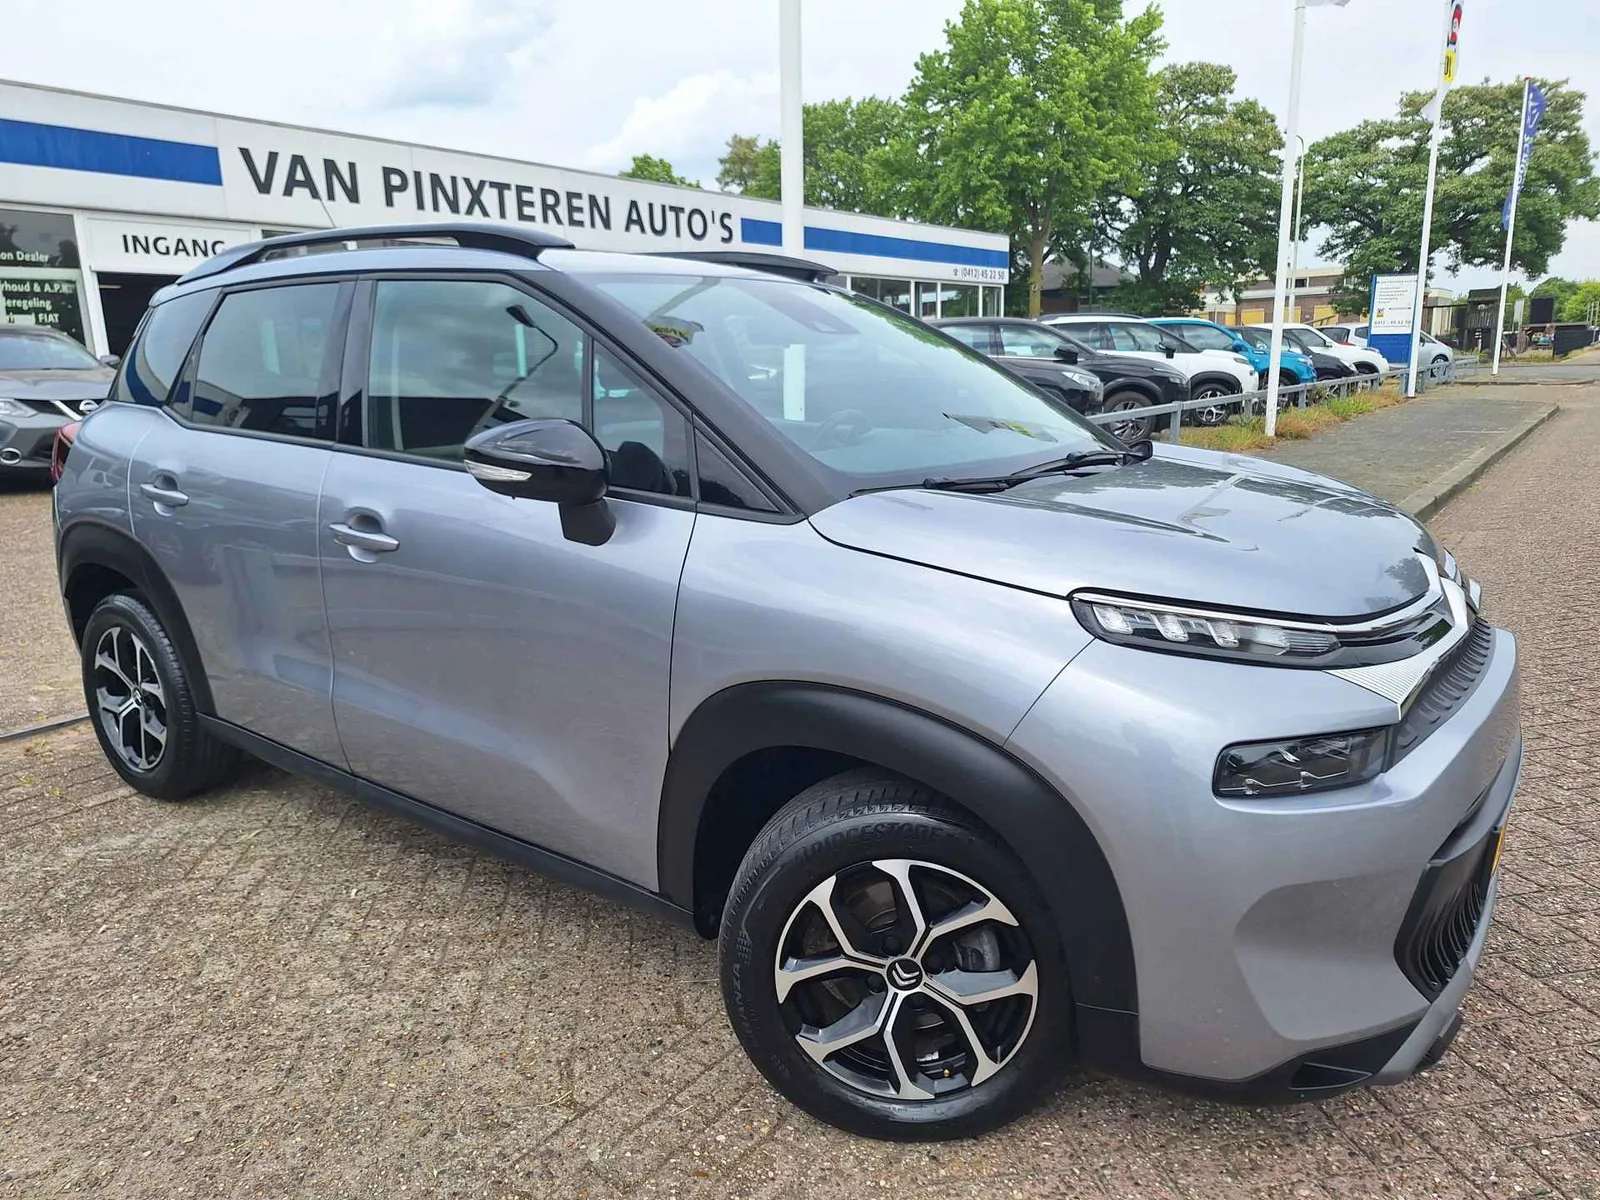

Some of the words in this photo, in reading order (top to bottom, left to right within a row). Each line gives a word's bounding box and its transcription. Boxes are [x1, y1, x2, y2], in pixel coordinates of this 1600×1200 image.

[238, 147, 360, 204] VAN
[382, 166, 612, 230] PINXTEREN
[624, 200, 733, 243] AUTO'S
[16, 251, 49, 262] Dealer
[33, 282, 41, 292] &
[38, 313, 60, 323] FIAT
